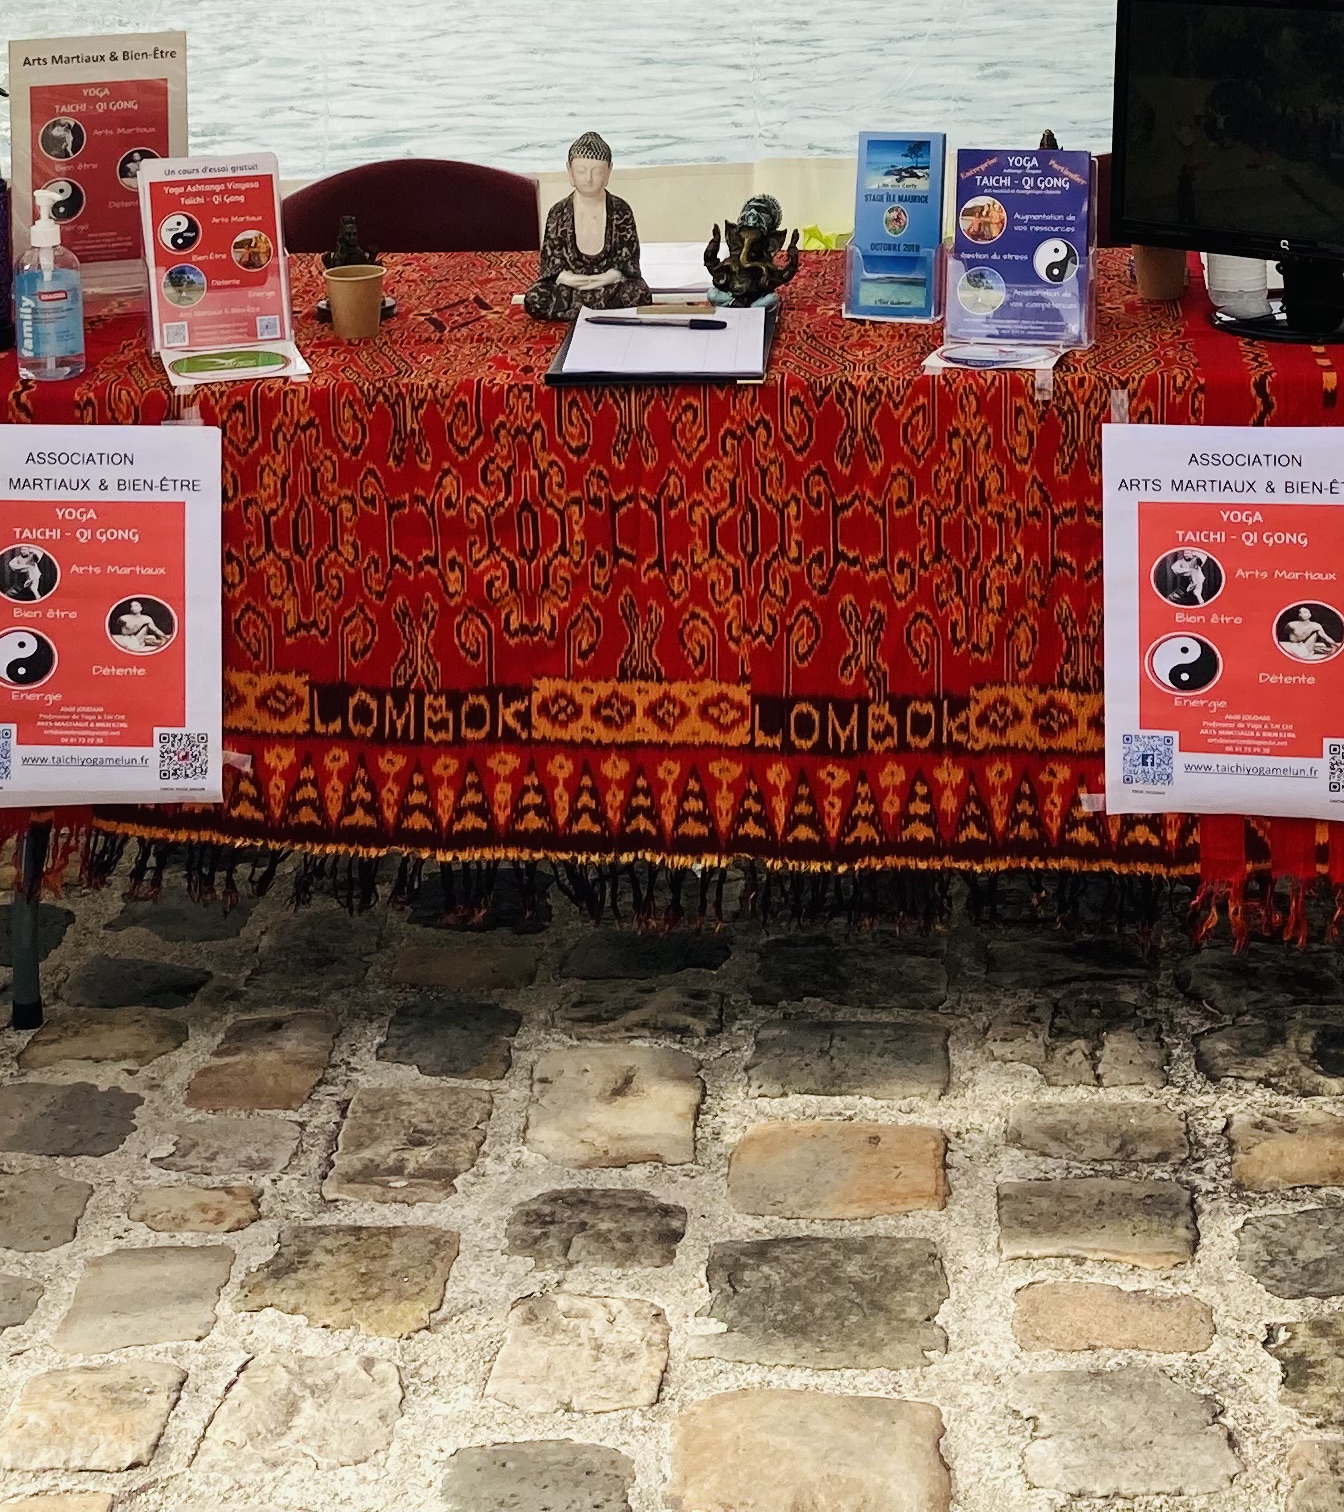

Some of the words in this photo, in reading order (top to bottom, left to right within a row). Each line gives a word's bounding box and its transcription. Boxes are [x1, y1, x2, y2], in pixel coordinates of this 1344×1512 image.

[23, 56, 48, 67] Arts
[51, 52, 105, 65] Martiaux
[109, 51, 118, 61] &
[82, 87, 109, 97] YOGA
[55, 102, 86, 114] TAICHI
[96, 101, 107, 114] QI
[109, 100, 138, 112] GONG
[231, 164, 258, 173] gratuit
[1008, 156, 1038, 169] YOGA
[976, 176, 1010, 186] TAICHI
[1022, 177, 1033, 189] QI
[1037, 177, 1069, 190] GONG
[163, 186, 184, 195] Yoga
[25, 452, 135, 466] ASSOCIATION
[1188, 454, 1303, 467] ASSOCIATION
[9, 478, 91, 491] MARTIAUX
[98, 479, 108, 491] &
[117, 476, 202, 492] BIEN-ÊTRE
[1118, 479, 1162, 492] ARTS
[1171, 479, 1257, 493] MARTIAUX
[1265, 481, 1275, 493] &
[56, 508, 97, 522] YOGA
[1220, 510, 1263, 526] YOGA
[13, 528, 61, 540] TAICHI
[76, 528, 93, 544] QI
[96, 528, 140, 543] GONG
[1176, 531, 1226, 543] TAICHI
[1242, 531, 1257, 547] QI
[1263, 532, 1309, 547] GONG
[69, 564, 101, 575] Arts
[107, 564, 167, 575] Martiaux
[1235, 568, 1268, 580] Arts
[13, 608, 42, 618] Bien
[92, 665, 146, 676] Détente
[11, 691, 63, 706] Energie
[1174, 697, 1228, 713] Energie
[309, 692, 530, 741] LOMBOK
[753, 694, 973, 753] LOMBOK
[21, 755, 149, 767] www.taichiyogamelun.fr
[1184, 760, 1319, 778] www.taichiyogamelun.fr
